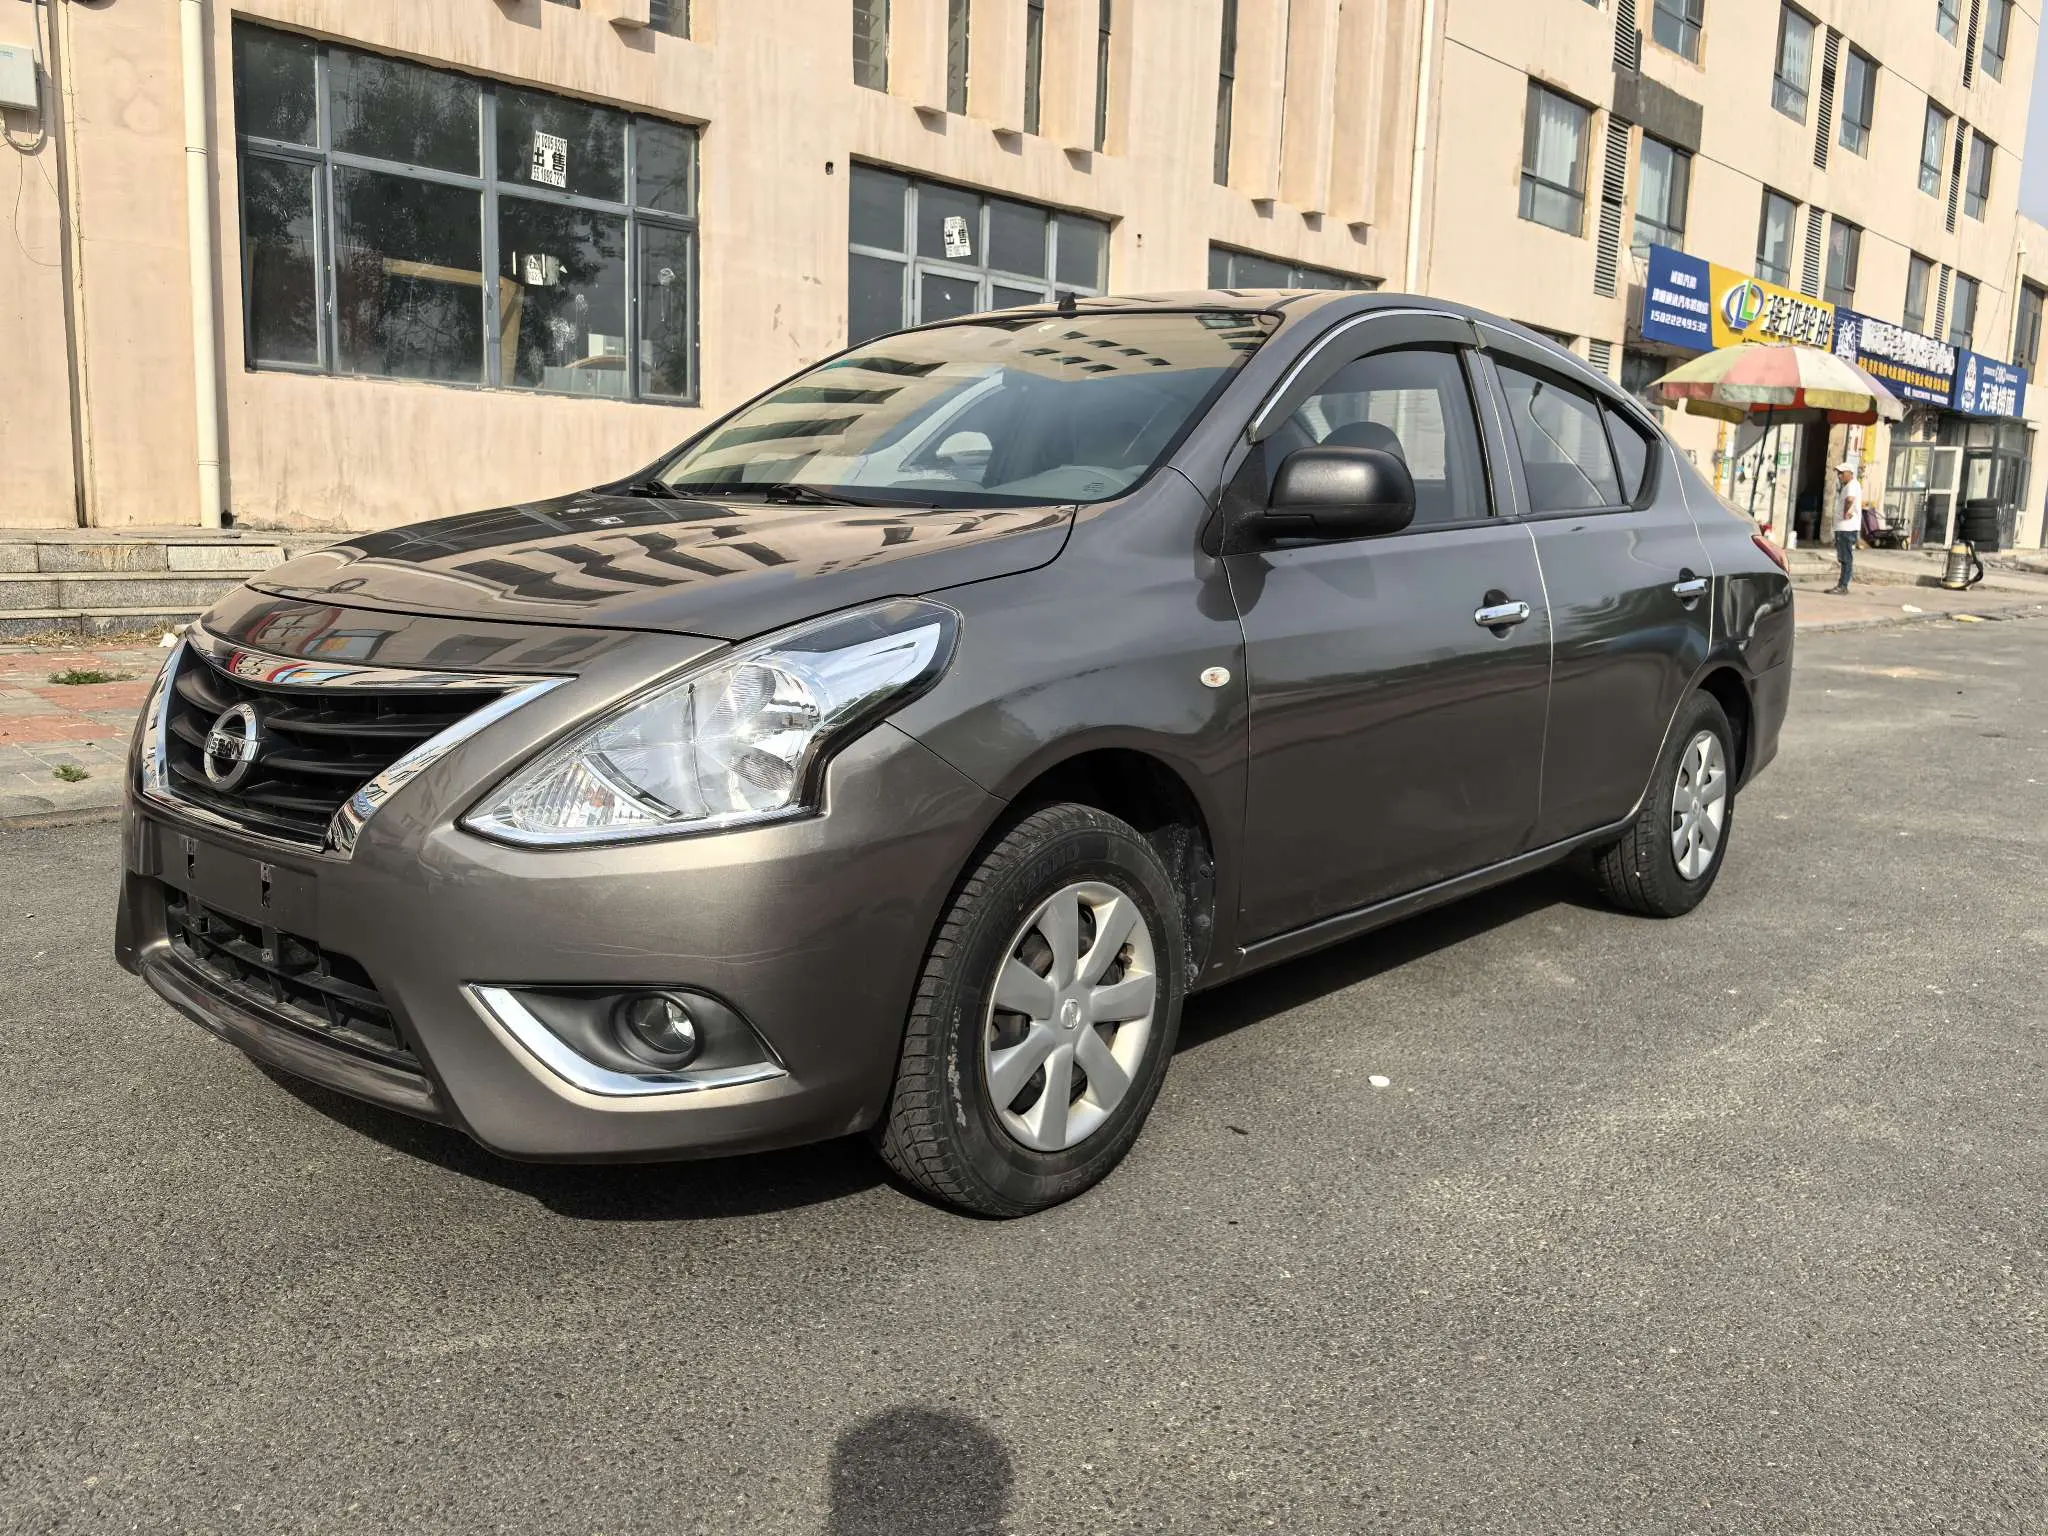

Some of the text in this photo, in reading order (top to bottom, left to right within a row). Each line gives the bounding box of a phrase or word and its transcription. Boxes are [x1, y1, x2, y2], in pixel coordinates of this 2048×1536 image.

[533, 147, 566, 172] 出售
[945, 229, 967, 245] 出售
[206, 734, 246, 757] NISSAN
